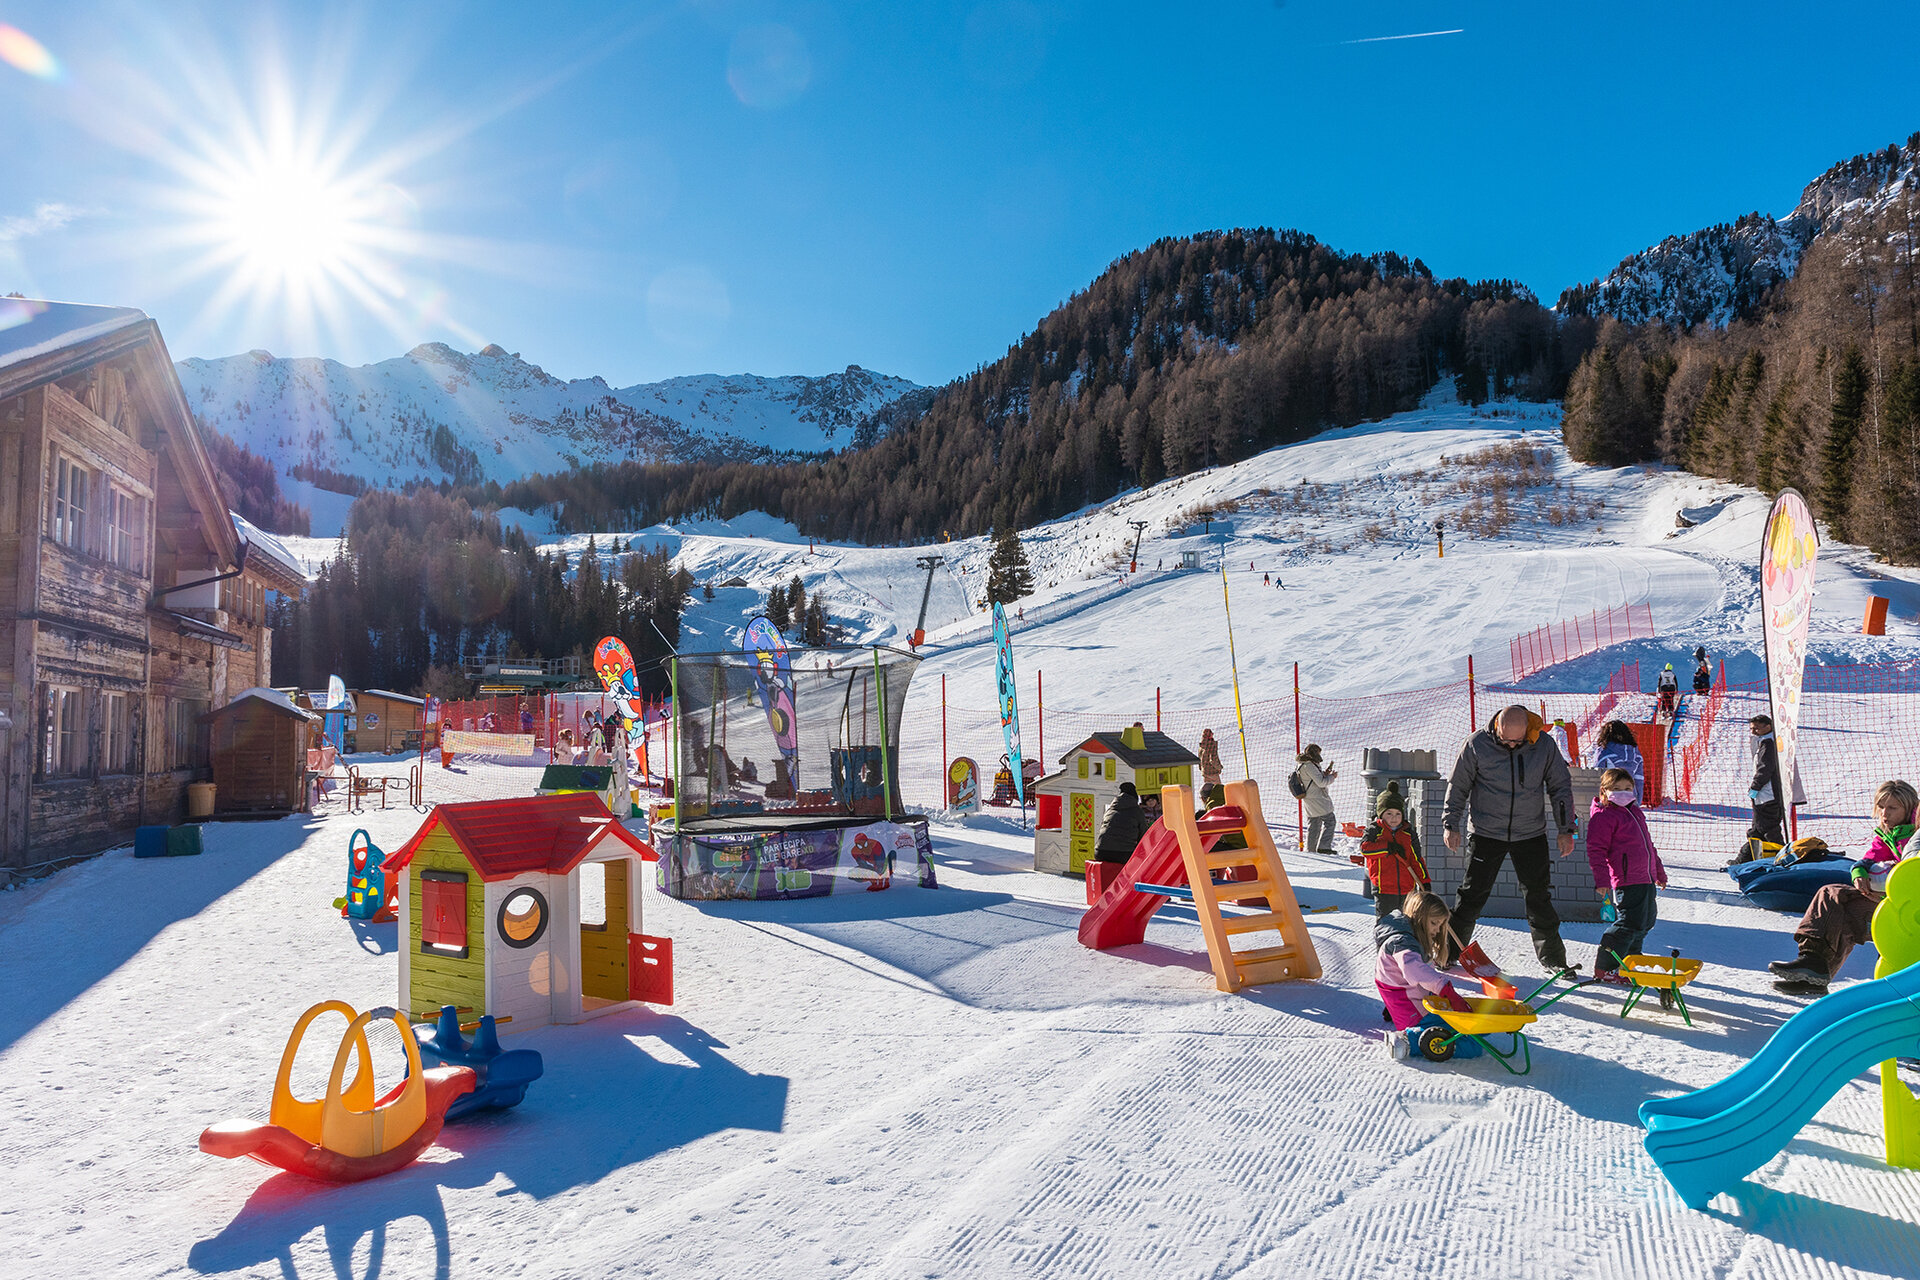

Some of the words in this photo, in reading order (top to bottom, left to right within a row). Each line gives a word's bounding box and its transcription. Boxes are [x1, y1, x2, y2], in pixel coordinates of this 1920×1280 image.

[763, 838, 806, 854] PARTECIPA
[759, 853, 779, 865] ALLE
[781, 847, 802, 860] GARE
